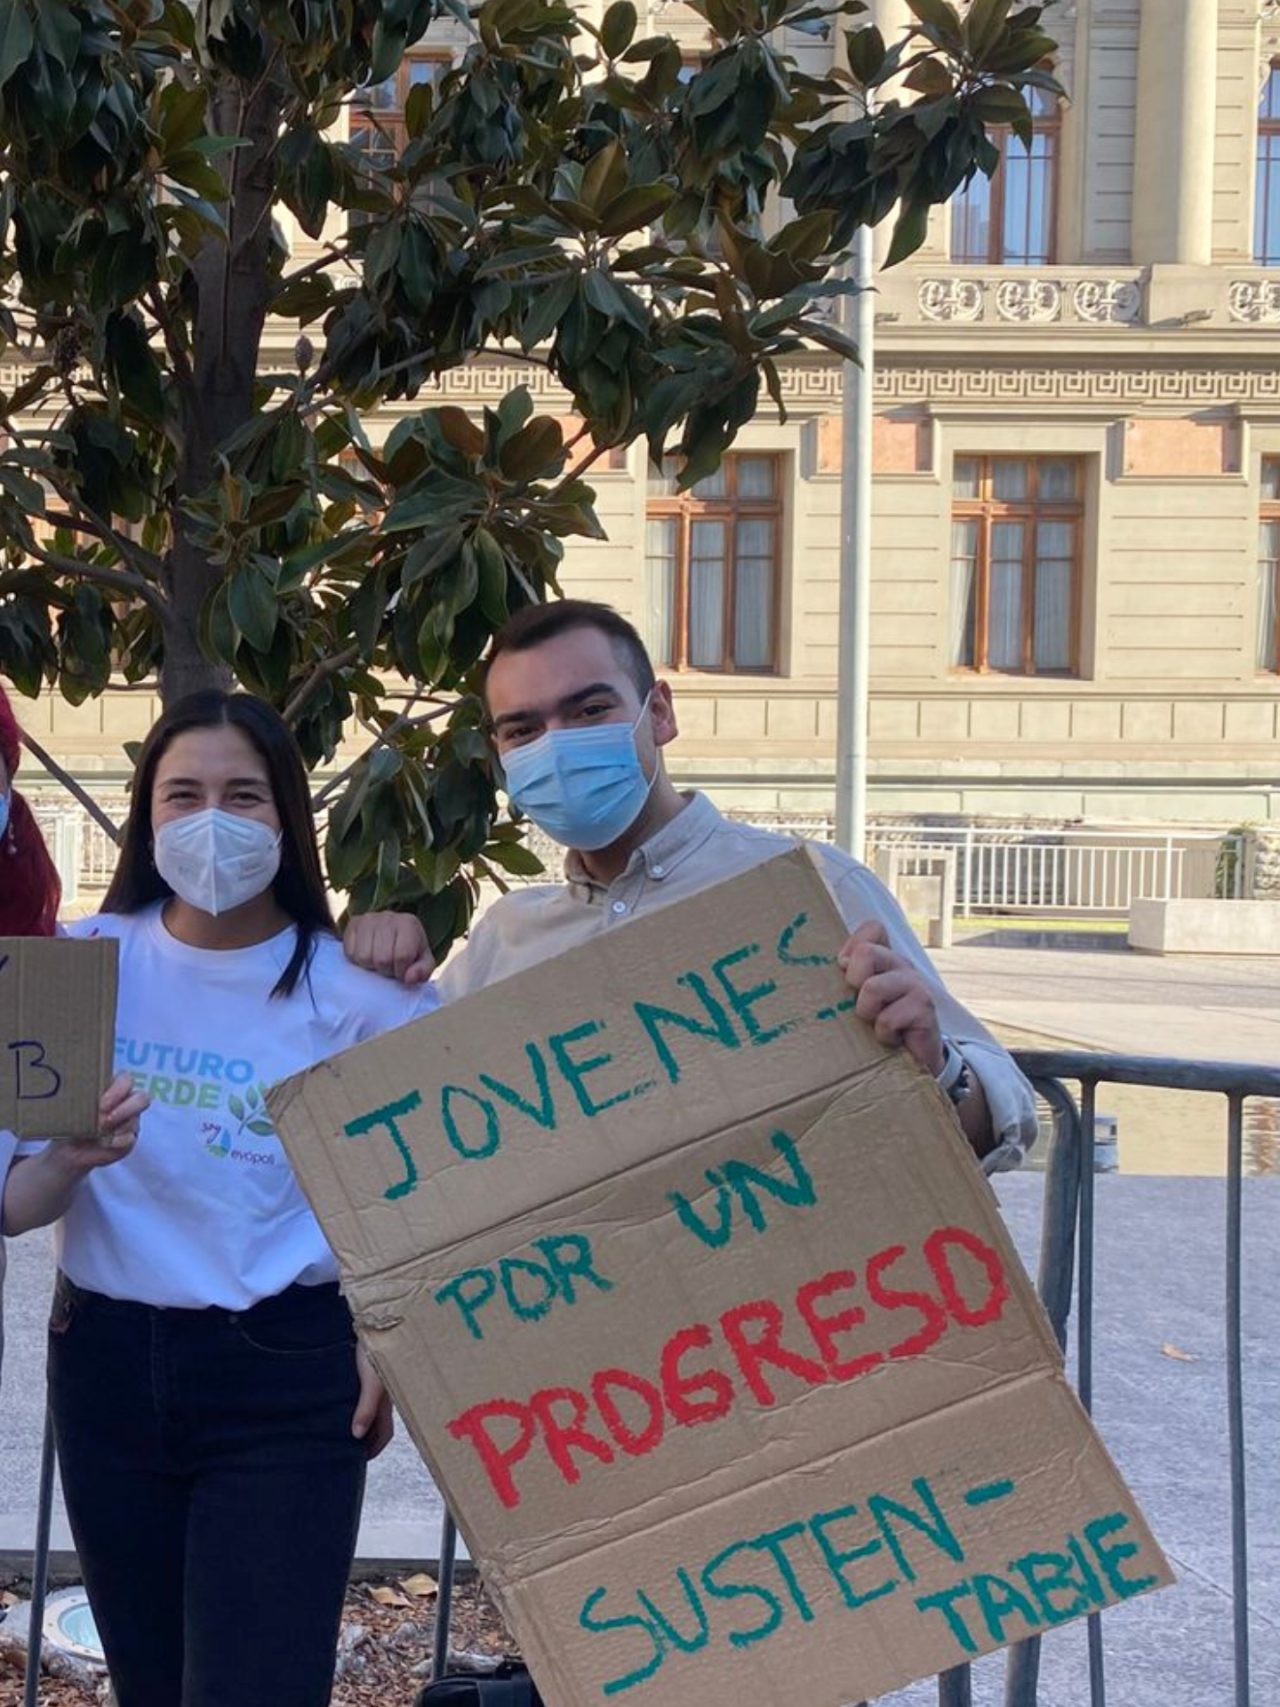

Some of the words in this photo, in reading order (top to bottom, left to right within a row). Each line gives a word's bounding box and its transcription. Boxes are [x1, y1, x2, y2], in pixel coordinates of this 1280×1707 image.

[8, 1039, 62, 1100] B
[132, 1071, 221, 1110] ERDE
[437, 1234, 612, 1339] POR
[667, 1131, 819, 1248] UN
[447, 1226, 1010, 1508] PROGRESO
[579, 1475, 1015, 1695] SUSTEN-
